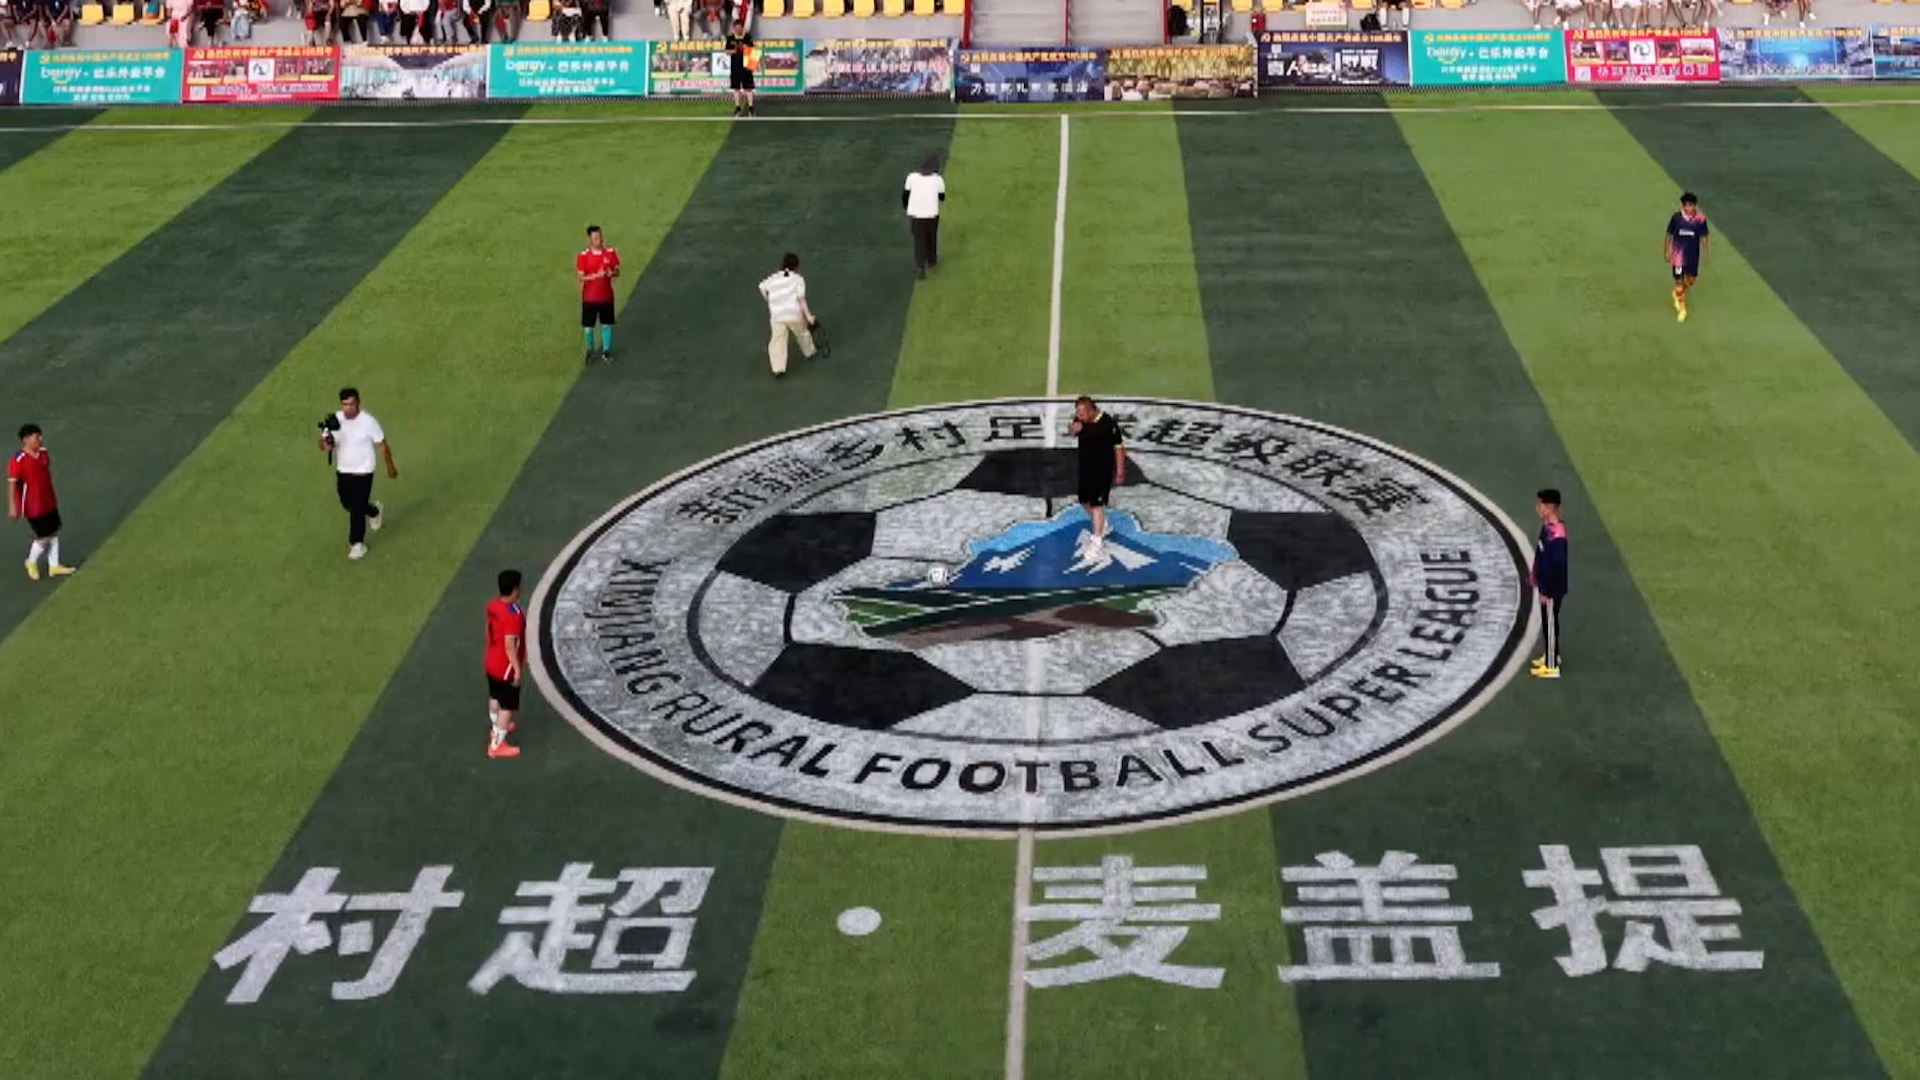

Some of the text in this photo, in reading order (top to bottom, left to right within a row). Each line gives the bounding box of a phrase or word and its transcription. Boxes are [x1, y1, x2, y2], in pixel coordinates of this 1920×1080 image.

[676, 414, 1431, 523] 新疆乡村足超级联赛
[583, 551, 1480, 793] XINJIANG RURAL FOOTBALL SUPER LEAGUE
